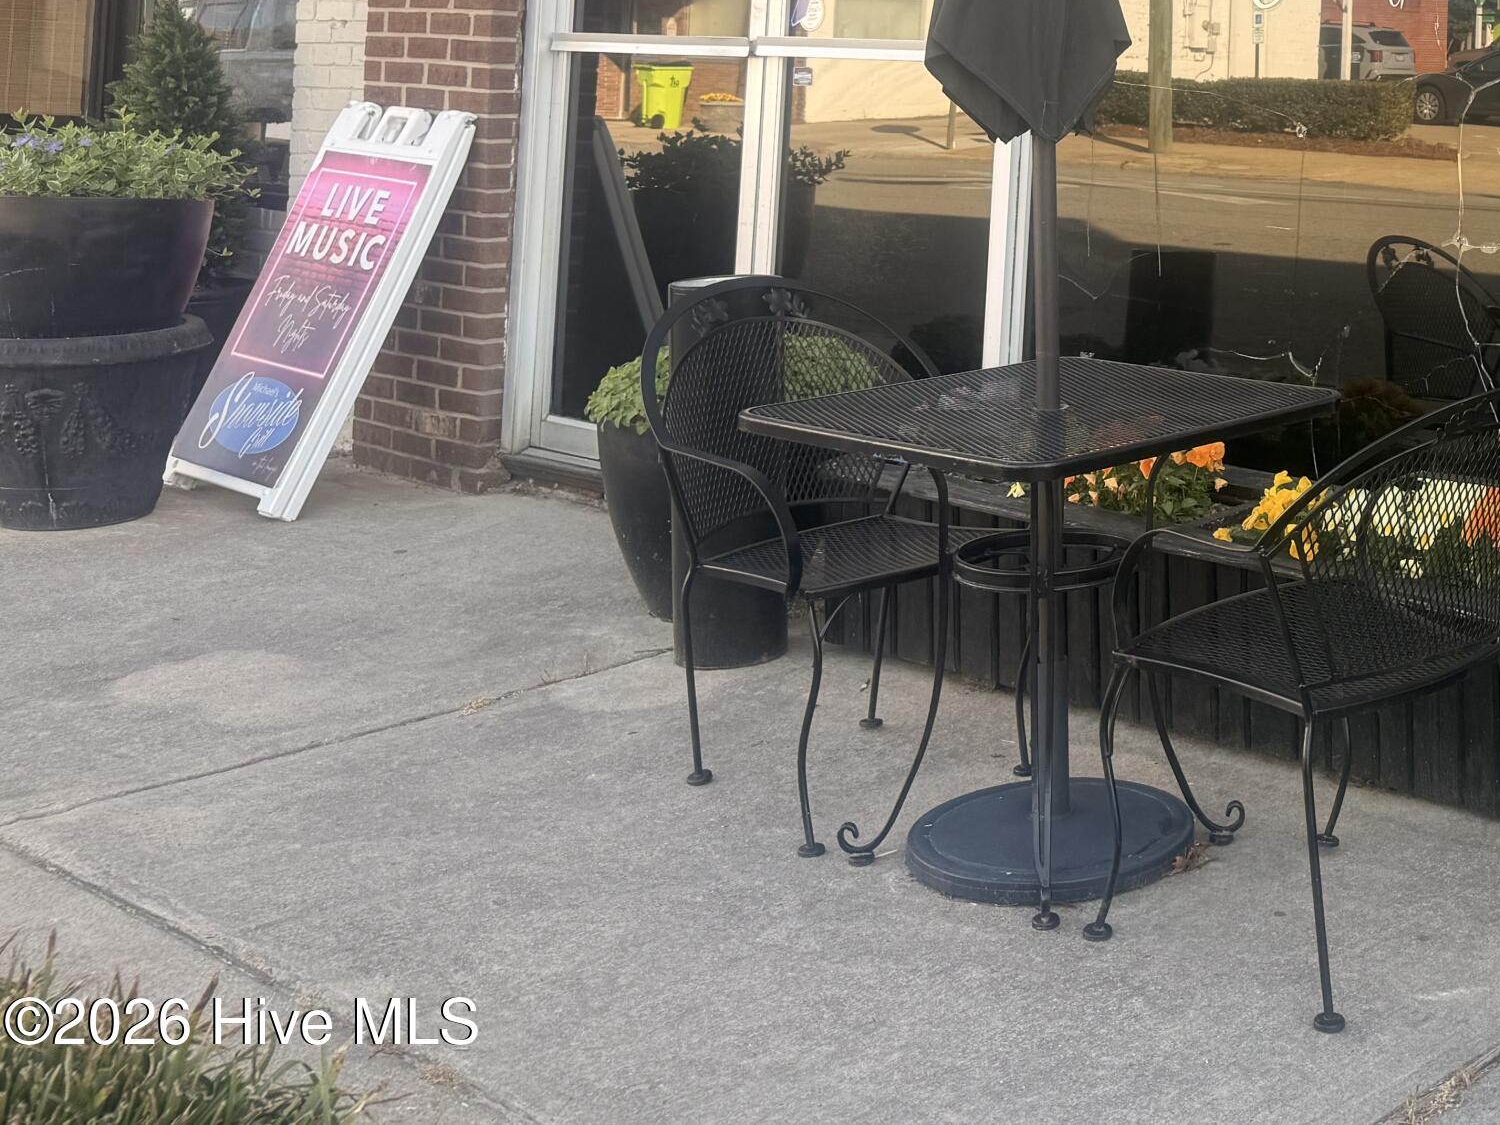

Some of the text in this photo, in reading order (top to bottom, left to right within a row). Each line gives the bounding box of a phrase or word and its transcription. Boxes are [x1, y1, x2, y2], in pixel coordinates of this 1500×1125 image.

[321, 182, 391, 226] LIVE
[286, 221, 386, 270] MUSIC
[265, 275, 351, 330] Friday and Saturday
[273, 314, 316, 353] Nights
